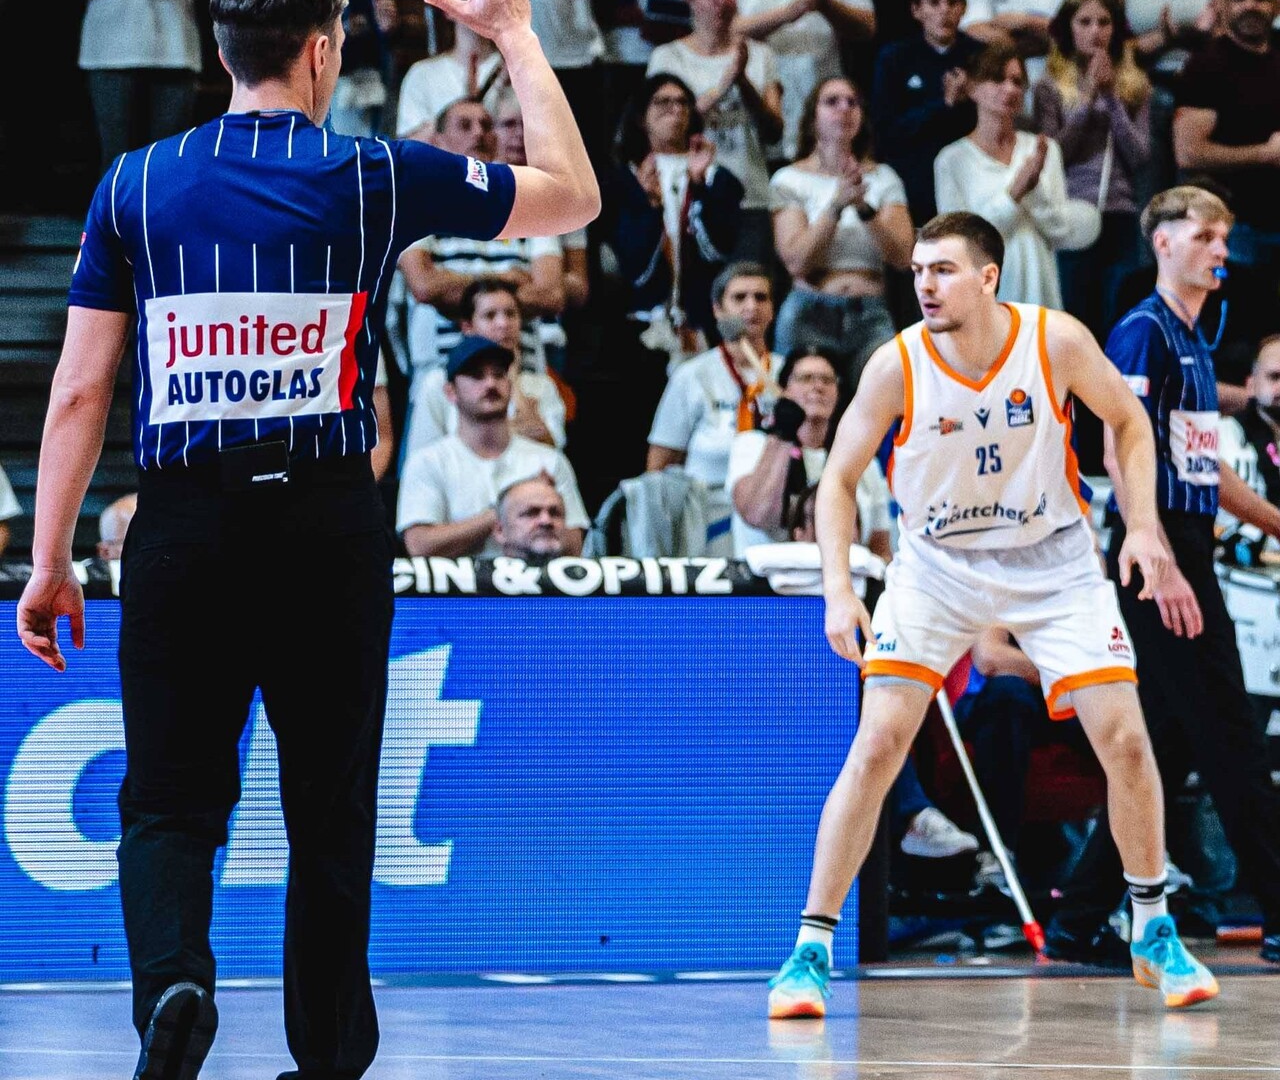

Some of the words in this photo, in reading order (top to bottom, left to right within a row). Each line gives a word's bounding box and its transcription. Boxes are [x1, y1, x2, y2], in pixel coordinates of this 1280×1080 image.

[165, 309, 328, 368] junited
[167, 367, 325, 407] AUTOGLAS
[975, 443, 1002, 476] 25
[491, 556, 543, 596] &
[548, 556, 733, 597] OPITZ
